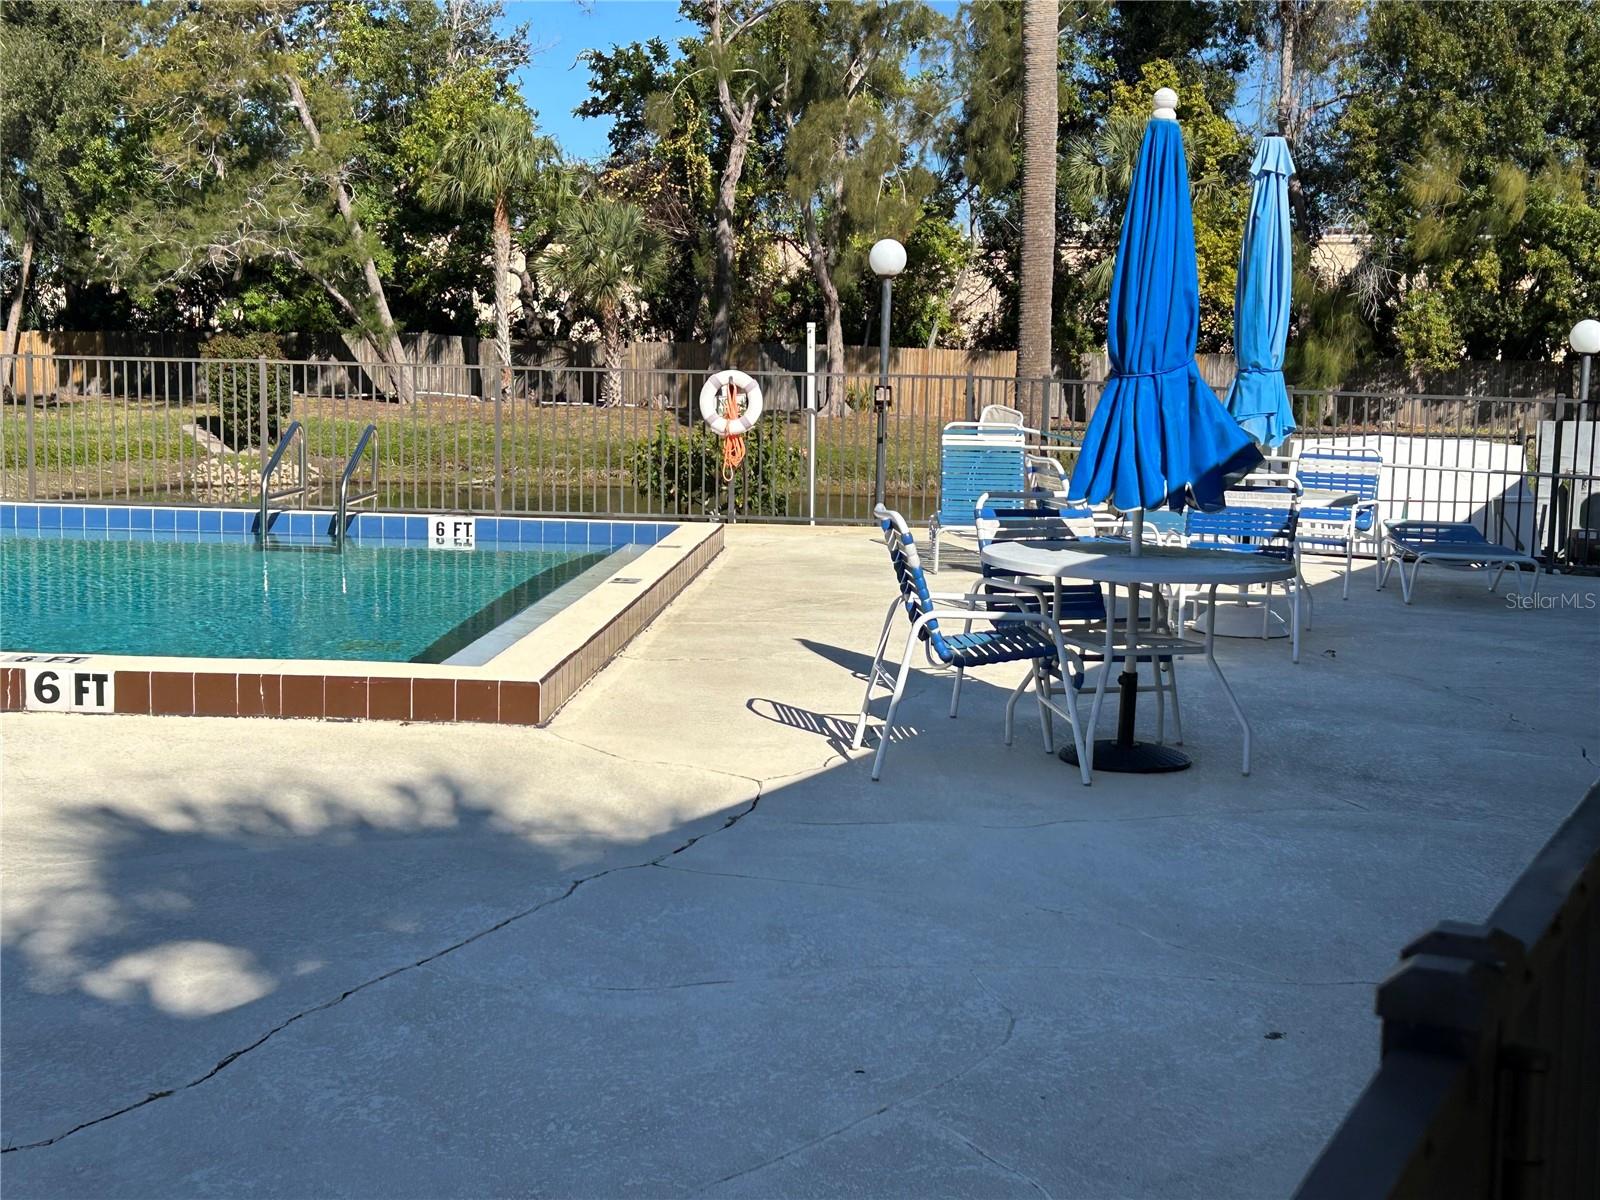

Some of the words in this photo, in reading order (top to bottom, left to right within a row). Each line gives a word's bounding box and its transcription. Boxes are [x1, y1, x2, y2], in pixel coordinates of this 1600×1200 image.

[436, 521, 445, 536] 6
[34, 671, 60, 704] 6
[74, 673, 108, 706] FT
